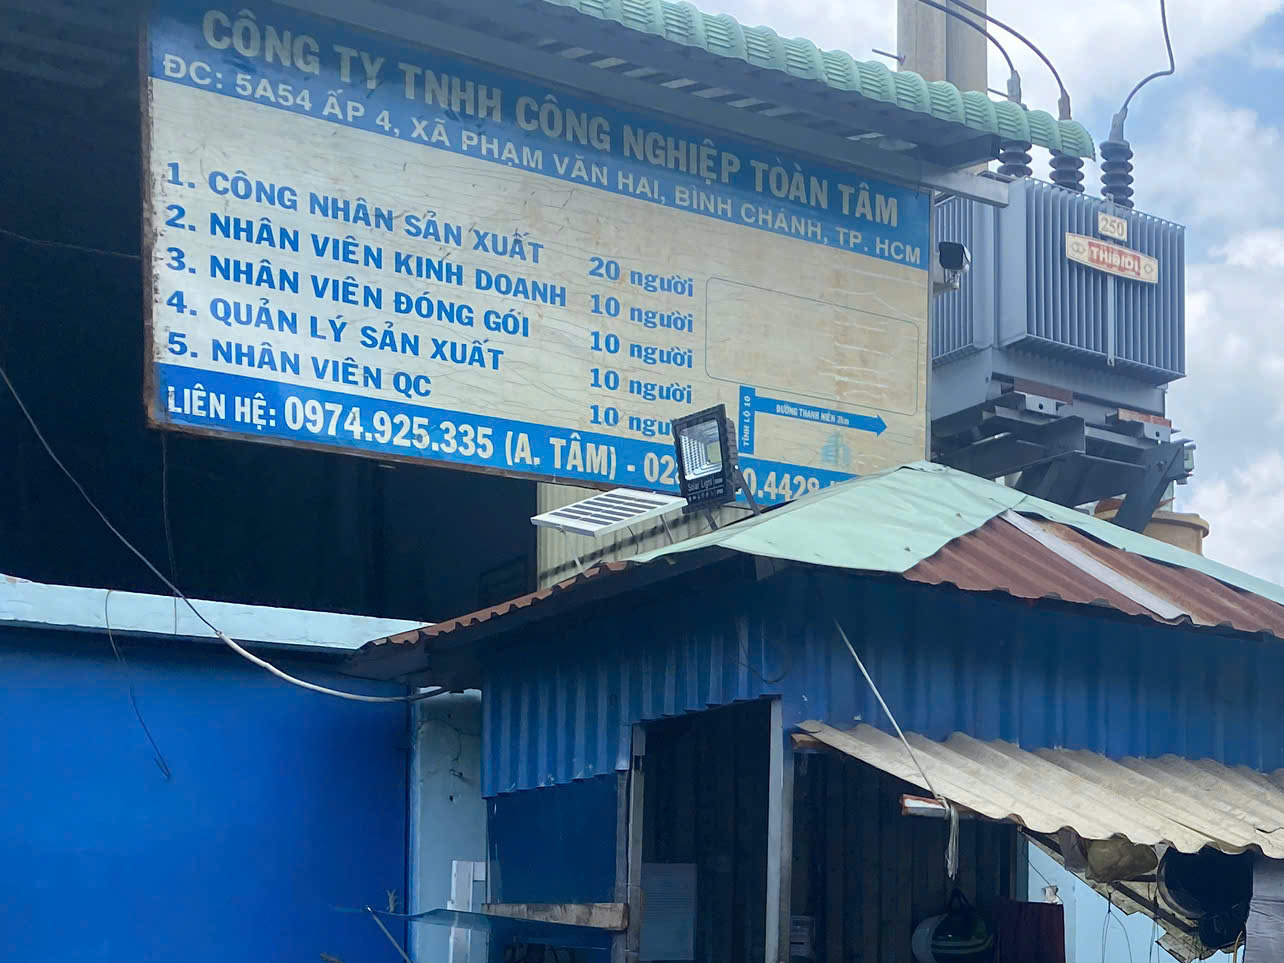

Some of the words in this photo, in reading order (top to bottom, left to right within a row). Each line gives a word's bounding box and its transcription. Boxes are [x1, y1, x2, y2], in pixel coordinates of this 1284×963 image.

[202, 9, 320, 75] CÔNG
[333, 44, 386, 90] TY
[398, 62, 502, 121] TNHH
[516, 94, 611, 152] CÔNG
[623, 124, 740, 185] NGHIỆP
[751, 161, 828, 209] TOÀN
[838, 182, 898, 228] TÂM
[162, 53, 223, 90] ĐC:
[235, 73, 312, 111] 5A54
[322, 89, 365, 123] ẤP
[376, 110, 400, 136] 4,
[410, 117, 450, 147] XÃ
[462, 130, 543, 169] PHẠM
[553, 154, 608, 186] VĂN
[675, 184, 732, 217] BÌNH
[836, 227, 868, 251] TP.
[876, 236, 920, 264] HCM
[167, 162, 195, 189] 1.
[208, 170, 297, 210] CÔNG
[309, 192, 393, 232] NHÂN
[404, 210, 462, 247] SẢN
[473, 230, 544, 264] XUẤT
[1100, 216, 1124, 237] 250
[165, 204, 196, 232] 2.
[210, 212, 299, 253] NHÂN
[311, 234, 383, 270] VIÊN
[394, 252, 464, 287] KINH
[475, 268, 566, 307] DOANH
[165, 247, 196, 274] 3.
[210, 255, 299, 295] NHÂN
[311, 275, 383, 310] VIÊN
[394, 291, 474, 328] ĐÓNG
[484, 309, 529, 338] GÓI
[588, 256, 621, 281] 20
[630, 270, 694, 298] người
[166, 290, 198, 316] 4.
[210, 297, 298, 335] QUẢN
[310, 314, 347, 343] LÝ
[360, 321, 419, 357] SẢN
[430, 337, 504, 371] XUẤT
[590, 294, 621, 318] 10
[630, 306, 694, 334] người
[590, 330, 621, 354] 10
[629, 343, 694, 369] người
[167, 331, 198, 358] 5.
[212, 338, 300, 376] NHÂN
[311, 356, 382, 390] VIÊN
[393, 371, 432, 398] QC
[590, 367, 620, 391] 10
[629, 380, 693, 405] người
[166, 384, 226, 420] LIÊN
[235, 393, 276, 431] HỆ:
[285, 395, 494, 459] 0974.925.335
[505, 431, 540, 466] (A.
[550, 432, 617, 481] TÂM)
[590, 404, 619, 427] 10
